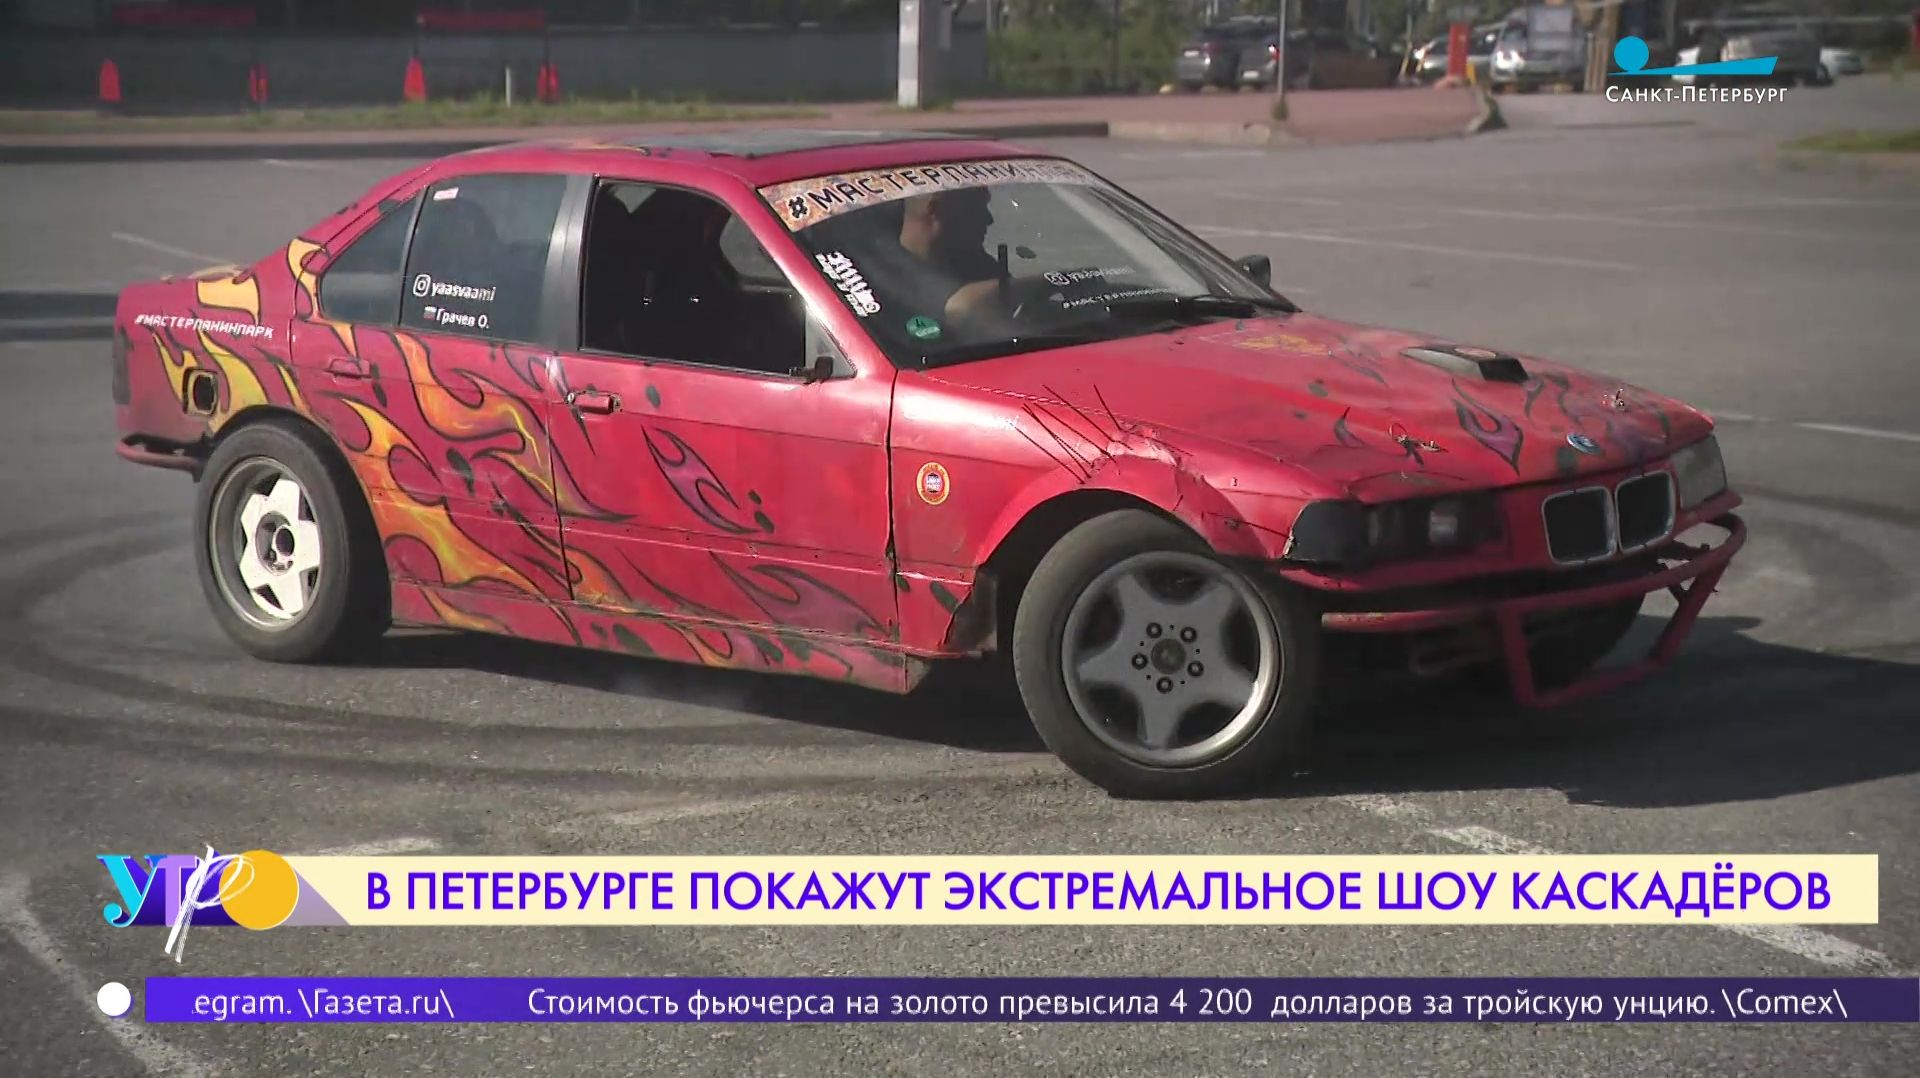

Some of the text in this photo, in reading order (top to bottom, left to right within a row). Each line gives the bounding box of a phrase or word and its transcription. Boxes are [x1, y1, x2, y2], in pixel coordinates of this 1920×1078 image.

[786, 162, 1086, 219] #МАСТЕРПАНИН
[430, 281, 497, 302] yaasvaami
[133, 313, 275, 339] #МАСТЕРПАНИНПАРК
[435, 307, 490, 329] Грачев О.
